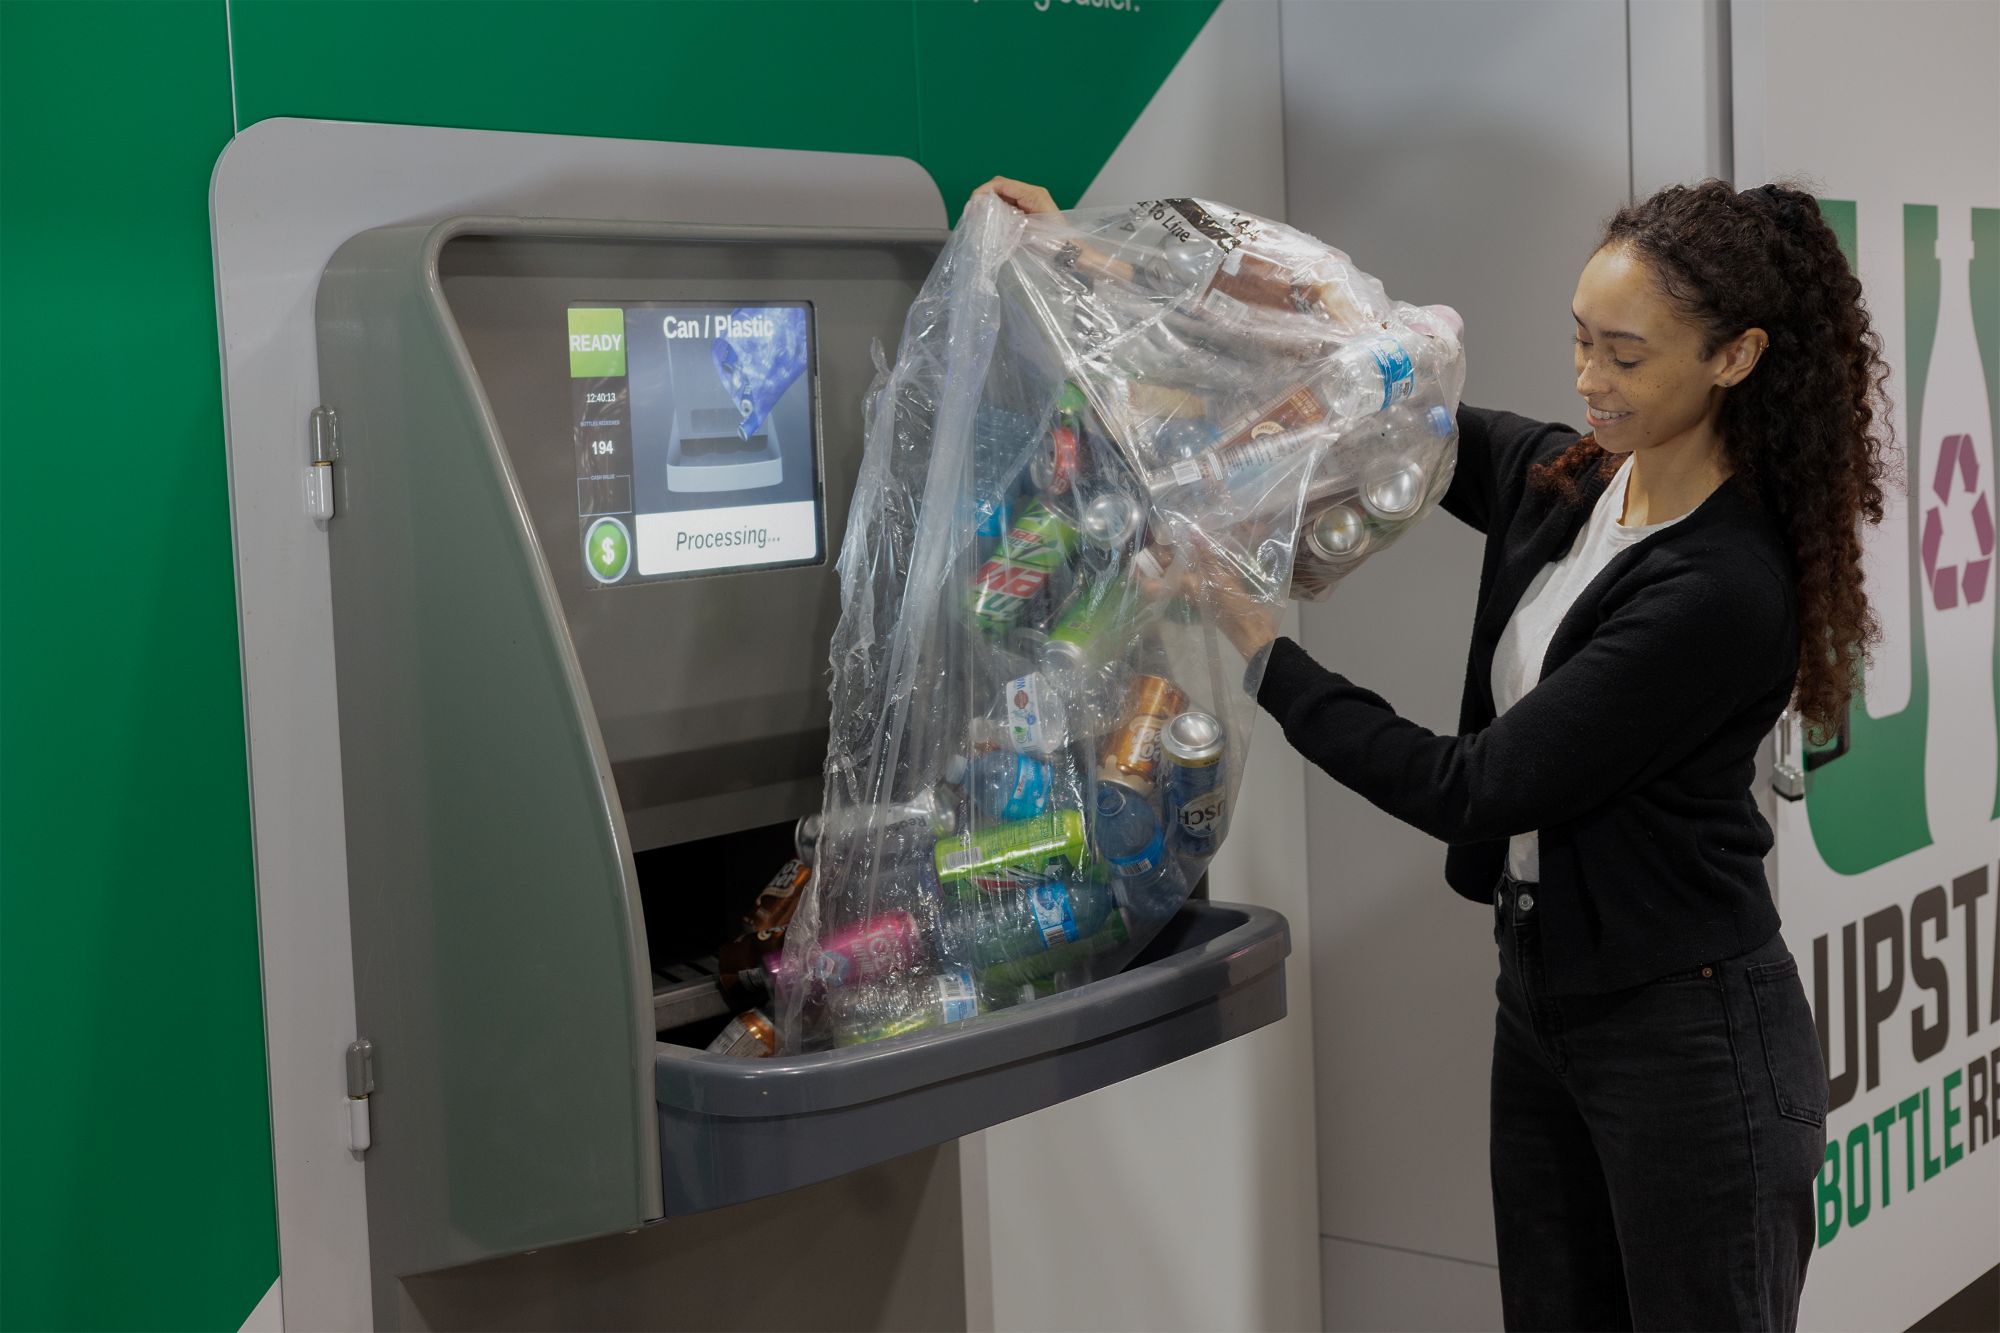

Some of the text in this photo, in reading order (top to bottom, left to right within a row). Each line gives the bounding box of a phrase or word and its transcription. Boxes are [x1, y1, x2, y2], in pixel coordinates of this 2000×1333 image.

[1161, 215, 1191, 243] Line
[662, 315, 699, 339] Can
[714, 314, 775, 338] Plastic
[569, 334, 622, 352] READY
[586, 392, 617, 403] 12:40:13
[591, 440, 614, 455] 194
[676, 524, 781, 551] Processing...
[1812, 857, 2000, 1113] UPST
